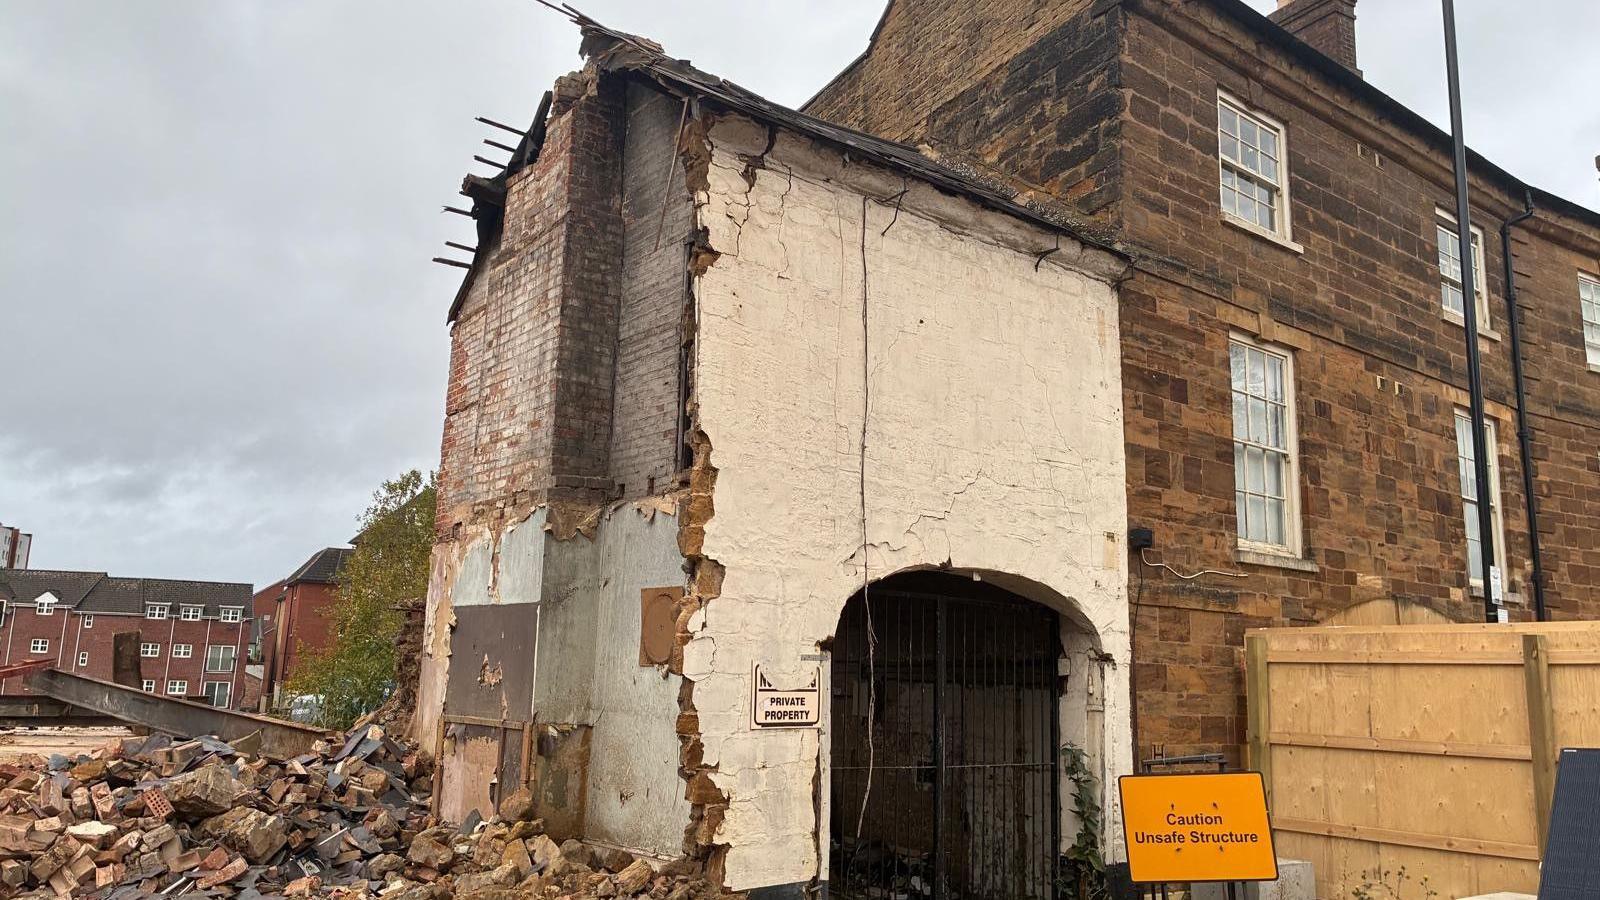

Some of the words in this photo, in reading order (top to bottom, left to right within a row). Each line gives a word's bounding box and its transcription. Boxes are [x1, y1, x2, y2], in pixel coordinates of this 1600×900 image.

[770, 697, 806, 706] PRIVATE
[764, 710, 810, 720] PROPERTY
[1166, 813, 1223, 825] Caution
[1135, 831, 1185, 843] Unsafe
[1190, 830, 1258, 843] Structure
